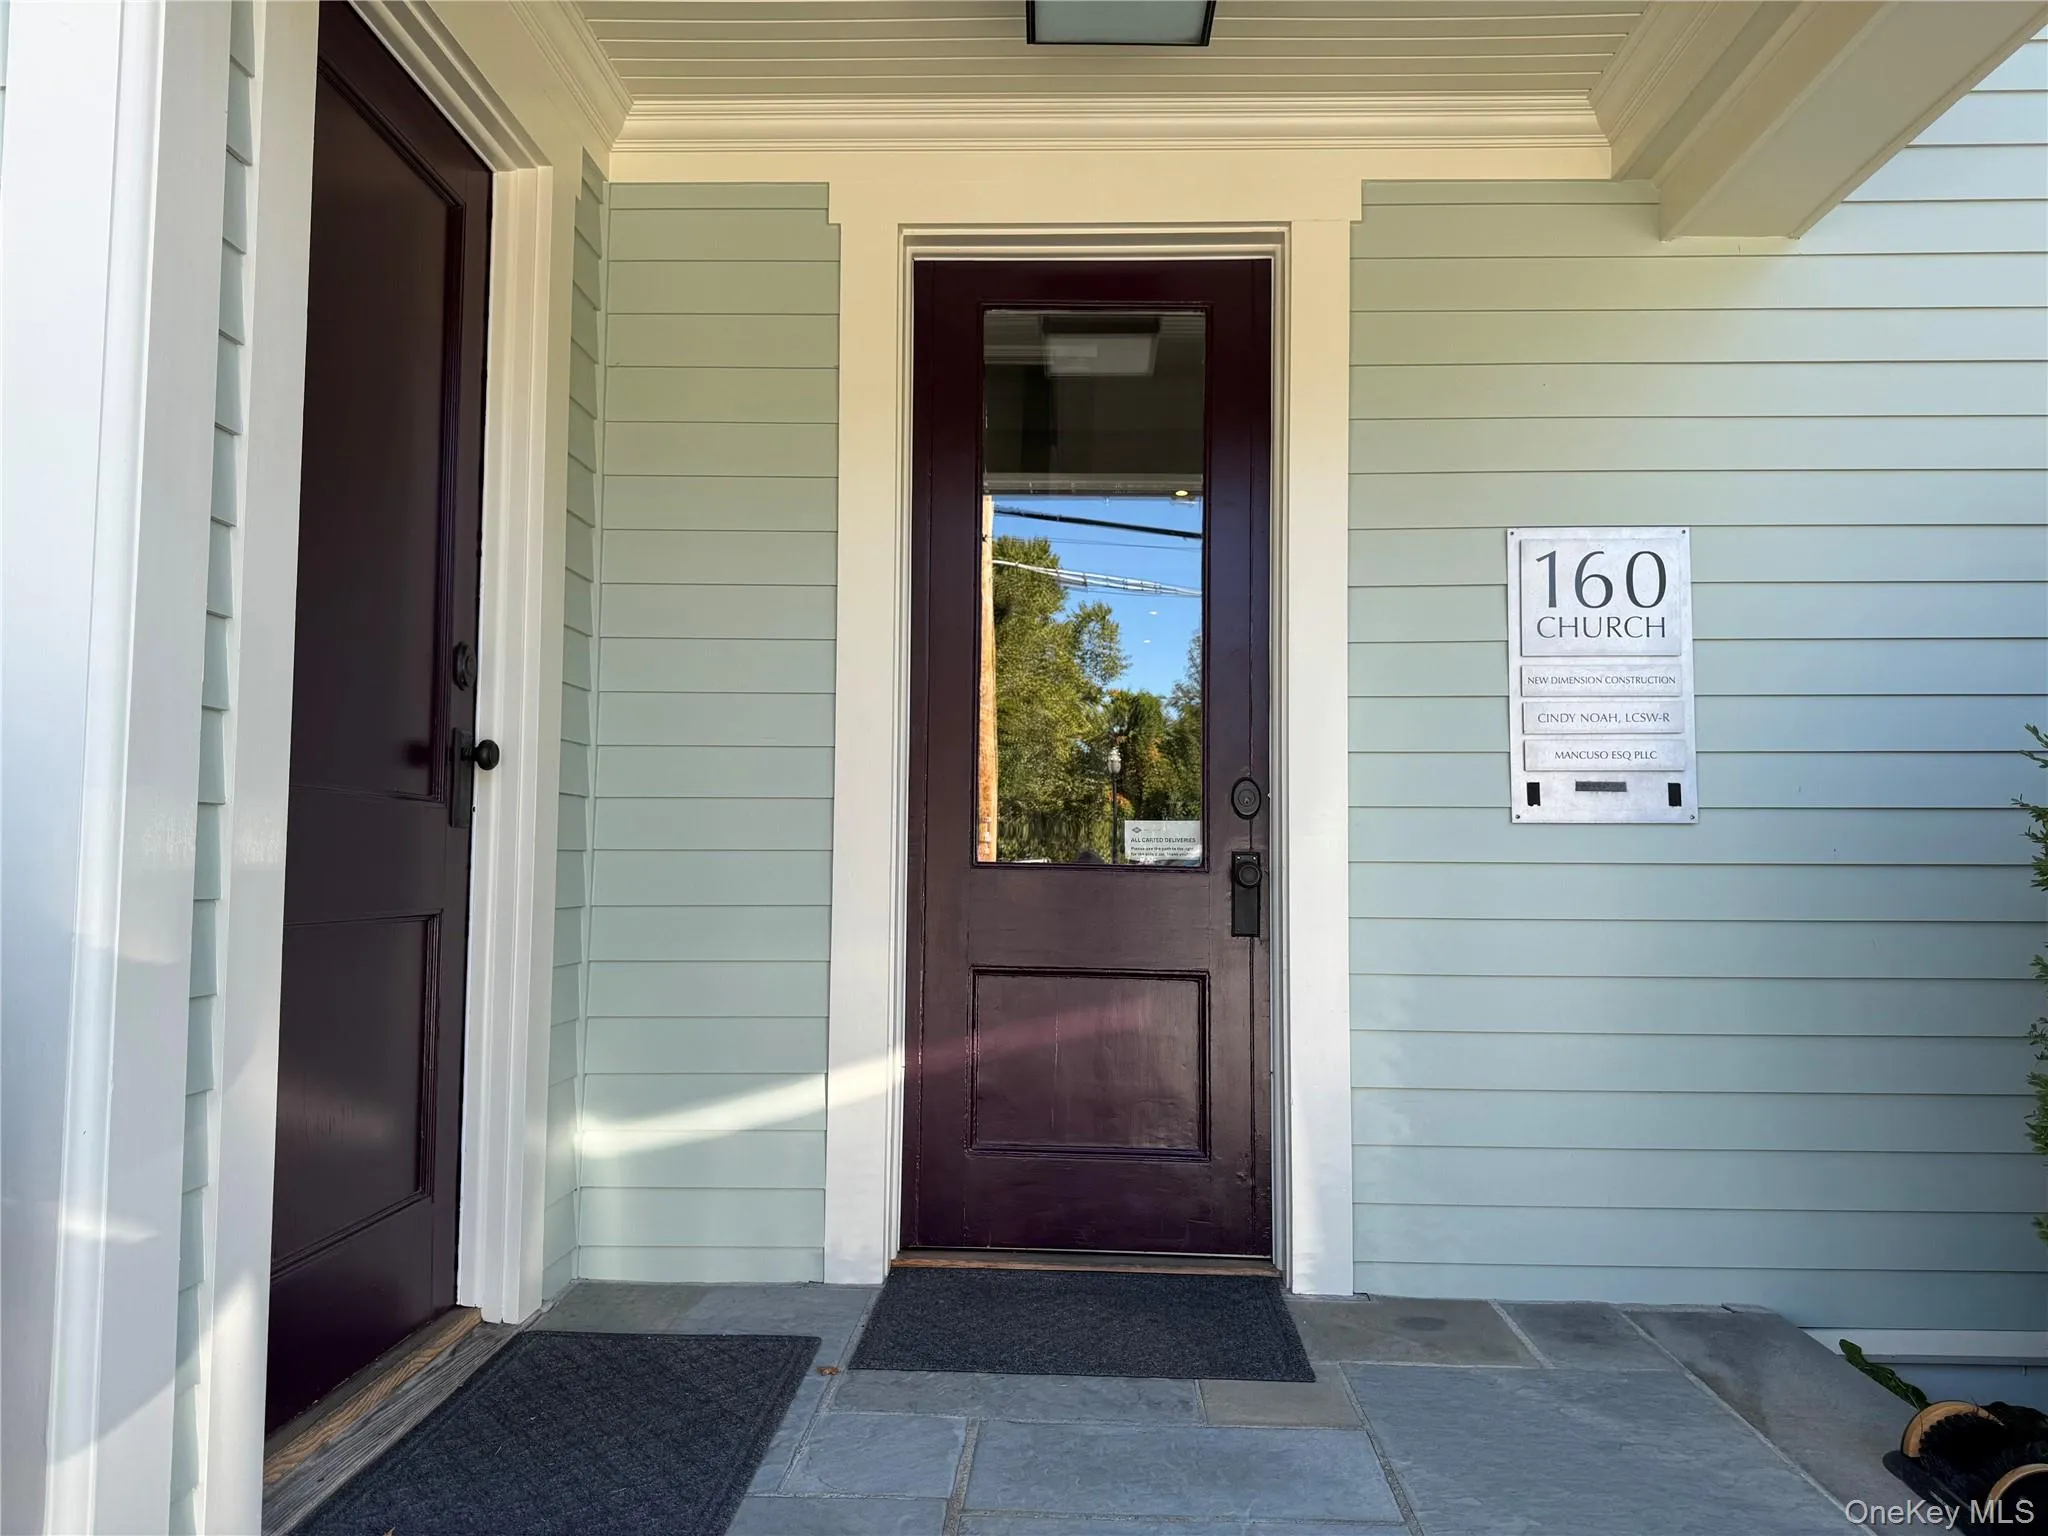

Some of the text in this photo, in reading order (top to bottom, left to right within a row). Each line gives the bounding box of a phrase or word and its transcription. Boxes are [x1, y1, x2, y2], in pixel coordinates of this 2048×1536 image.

[1535, 549, 1667, 609] 160
[1536, 615, 1666, 639] CHURCH
[1527, 675, 1676, 685] NEW DIMENSION CONSTRUCTION
[1537, 713, 1670, 725] CINDY NOAH, LCSW-R
[1554, 751, 1658, 761] MANCUSO ESQ PLLC
